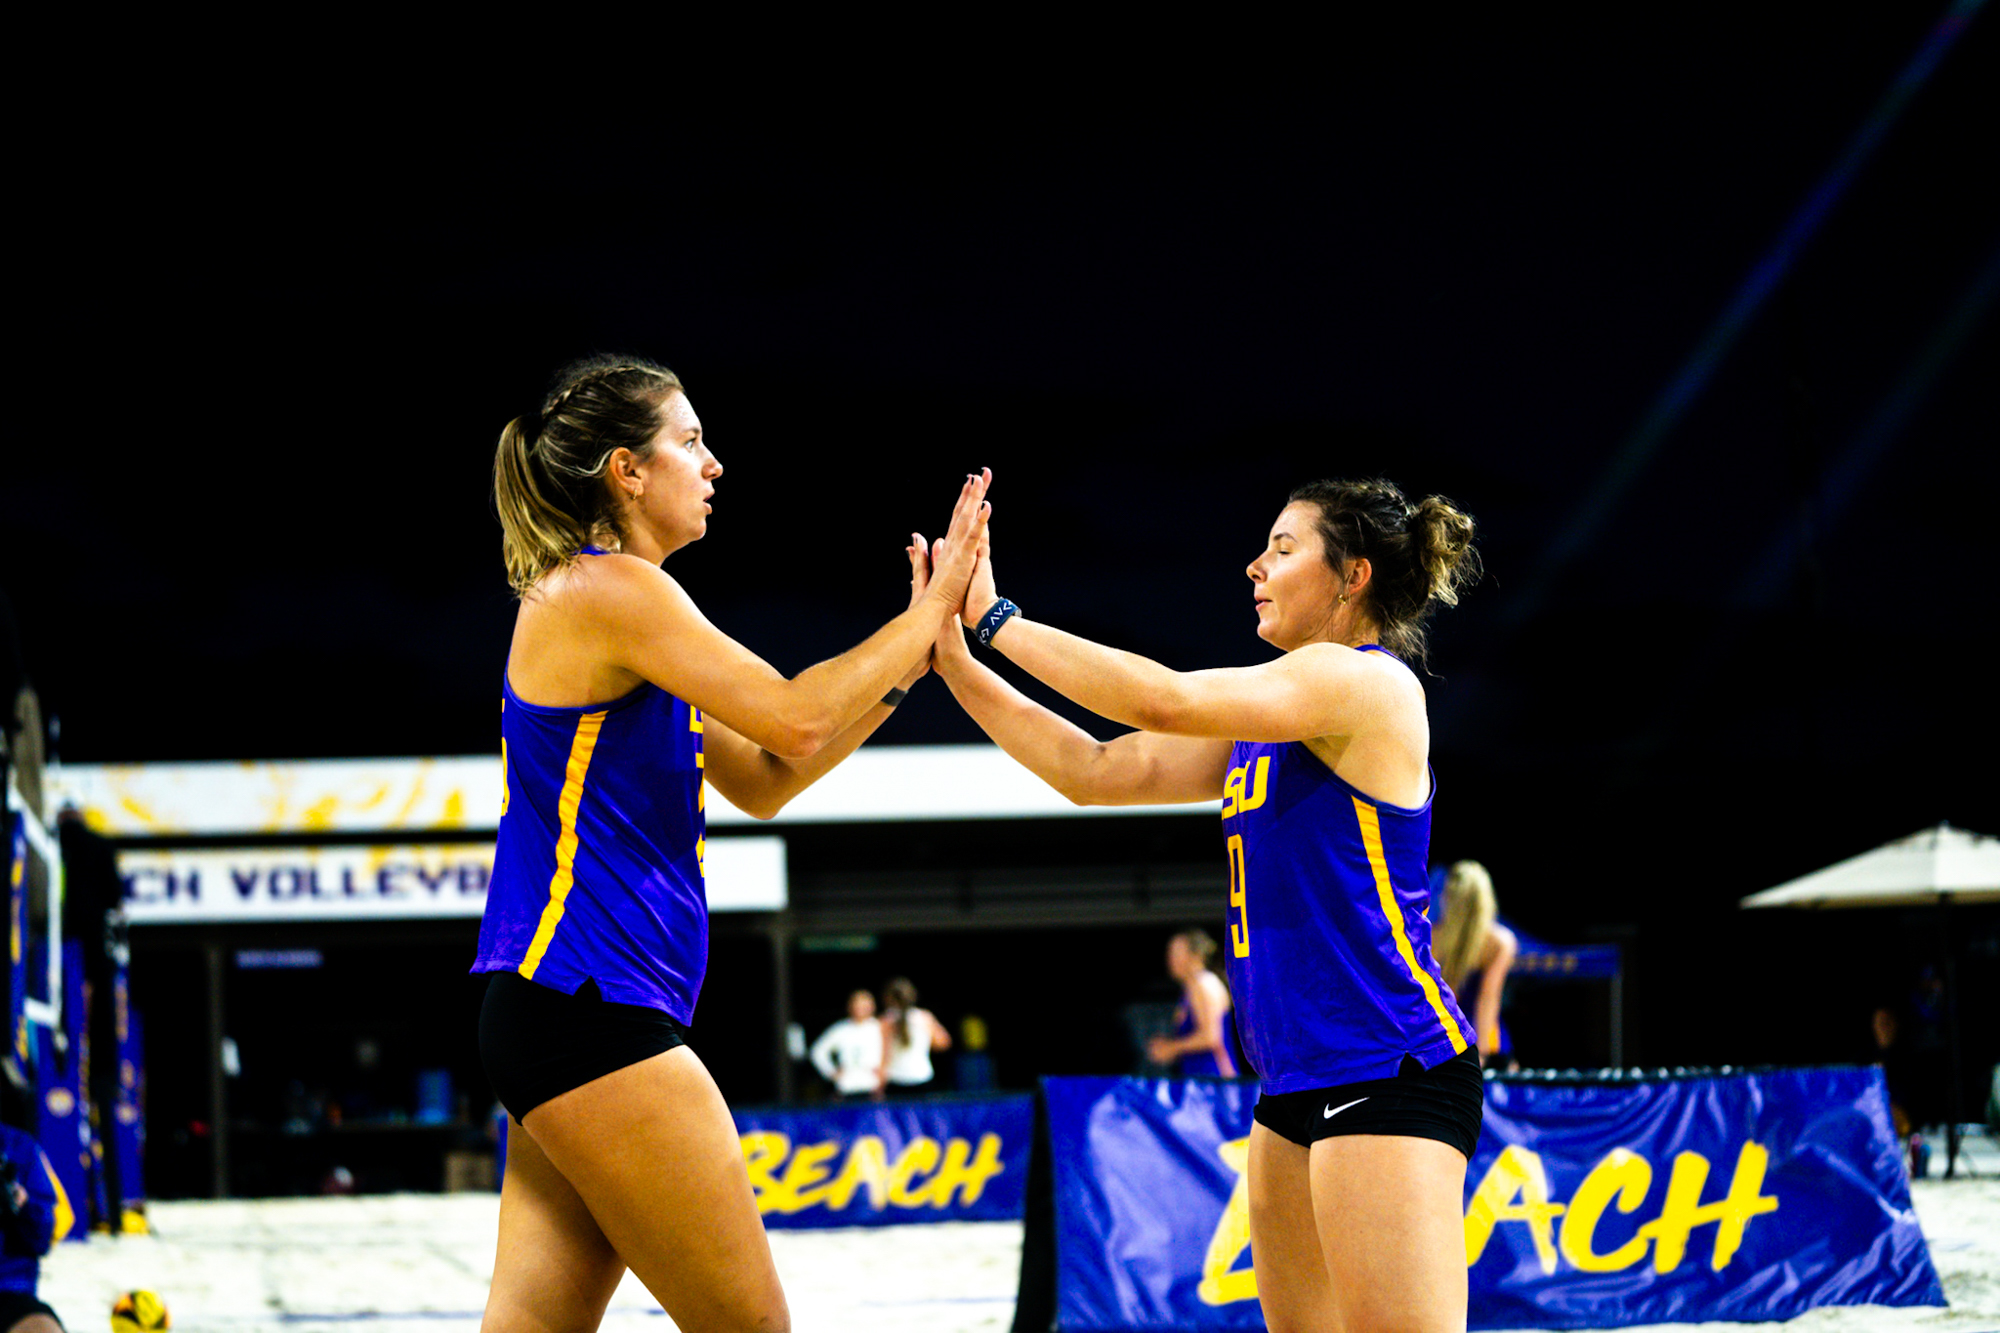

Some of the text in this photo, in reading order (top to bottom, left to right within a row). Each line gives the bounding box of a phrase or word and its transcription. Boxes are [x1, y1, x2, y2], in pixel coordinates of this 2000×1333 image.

[1222, 756, 1271, 821] SU
[1227, 833, 1250, 959] 9
[738, 1130, 1004, 1215] BEACH
